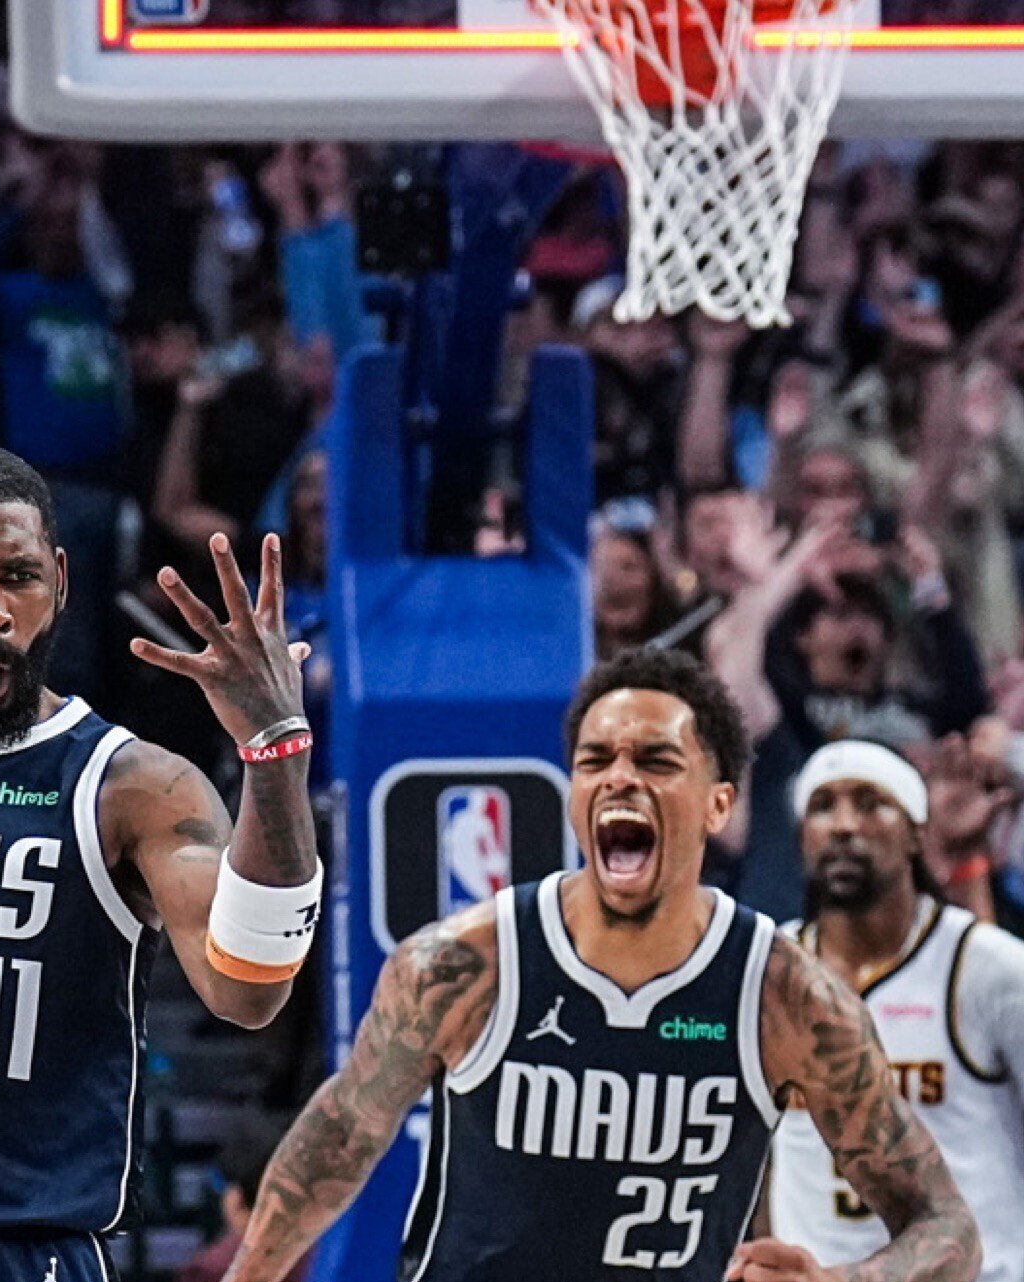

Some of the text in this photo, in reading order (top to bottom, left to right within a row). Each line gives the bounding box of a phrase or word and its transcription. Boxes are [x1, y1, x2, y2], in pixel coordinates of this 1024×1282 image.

[659, 1016, 727, 1041] chime
[495, 1060, 737, 1166] MAVS
[602, 1174, 719, 1270] 25
